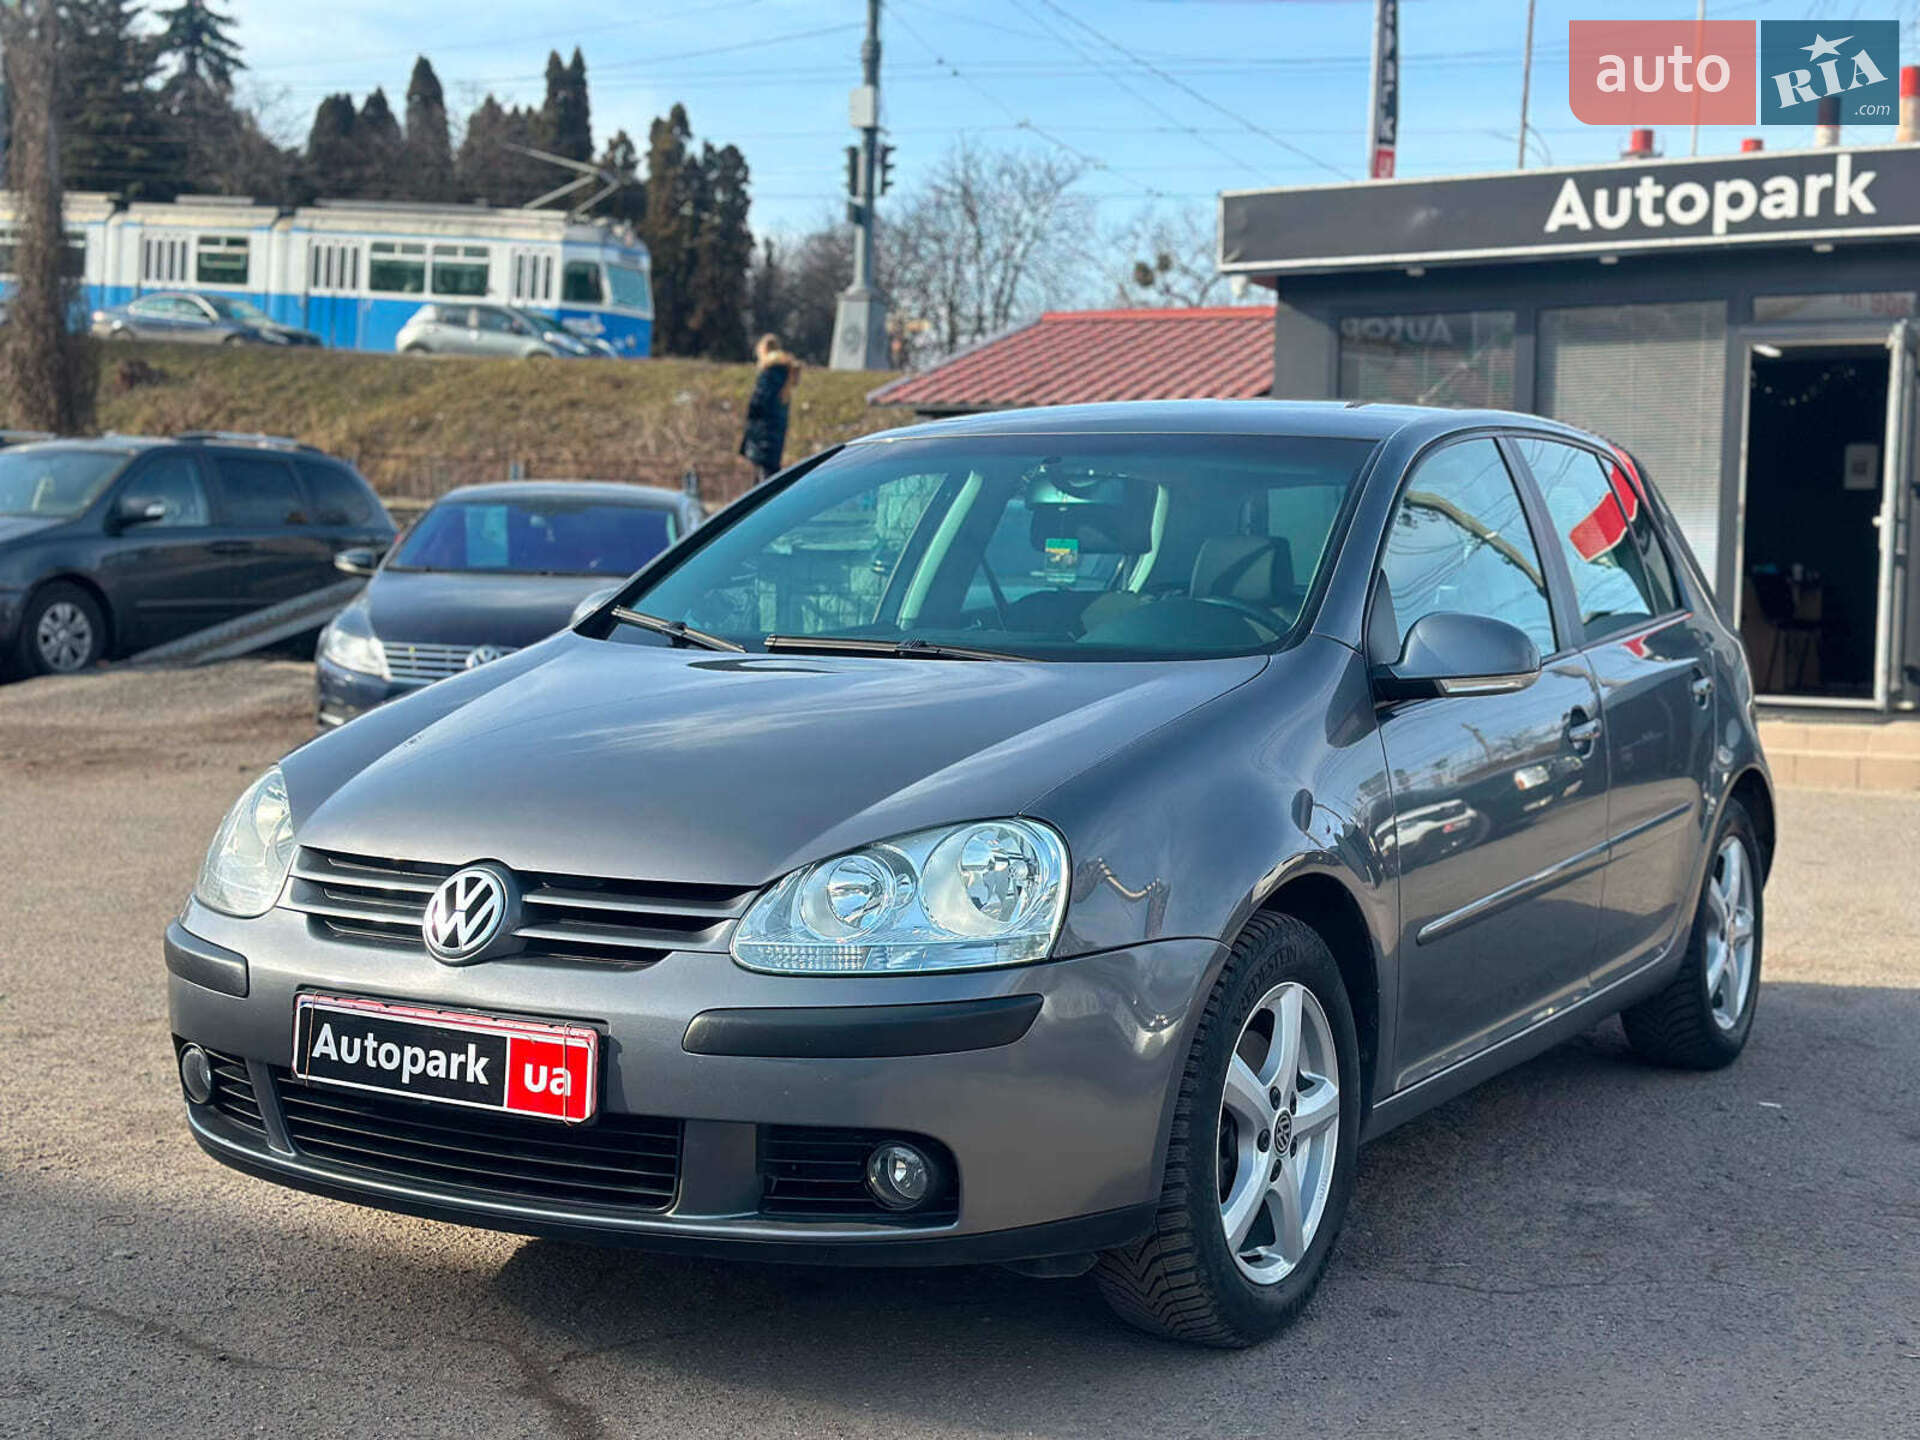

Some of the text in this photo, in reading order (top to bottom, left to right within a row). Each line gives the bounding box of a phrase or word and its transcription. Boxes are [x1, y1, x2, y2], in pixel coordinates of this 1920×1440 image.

[1544, 154, 1878, 235] Autopark
[425, 868, 504, 958] VW
[311, 1023, 573, 1096] Autopark ua
